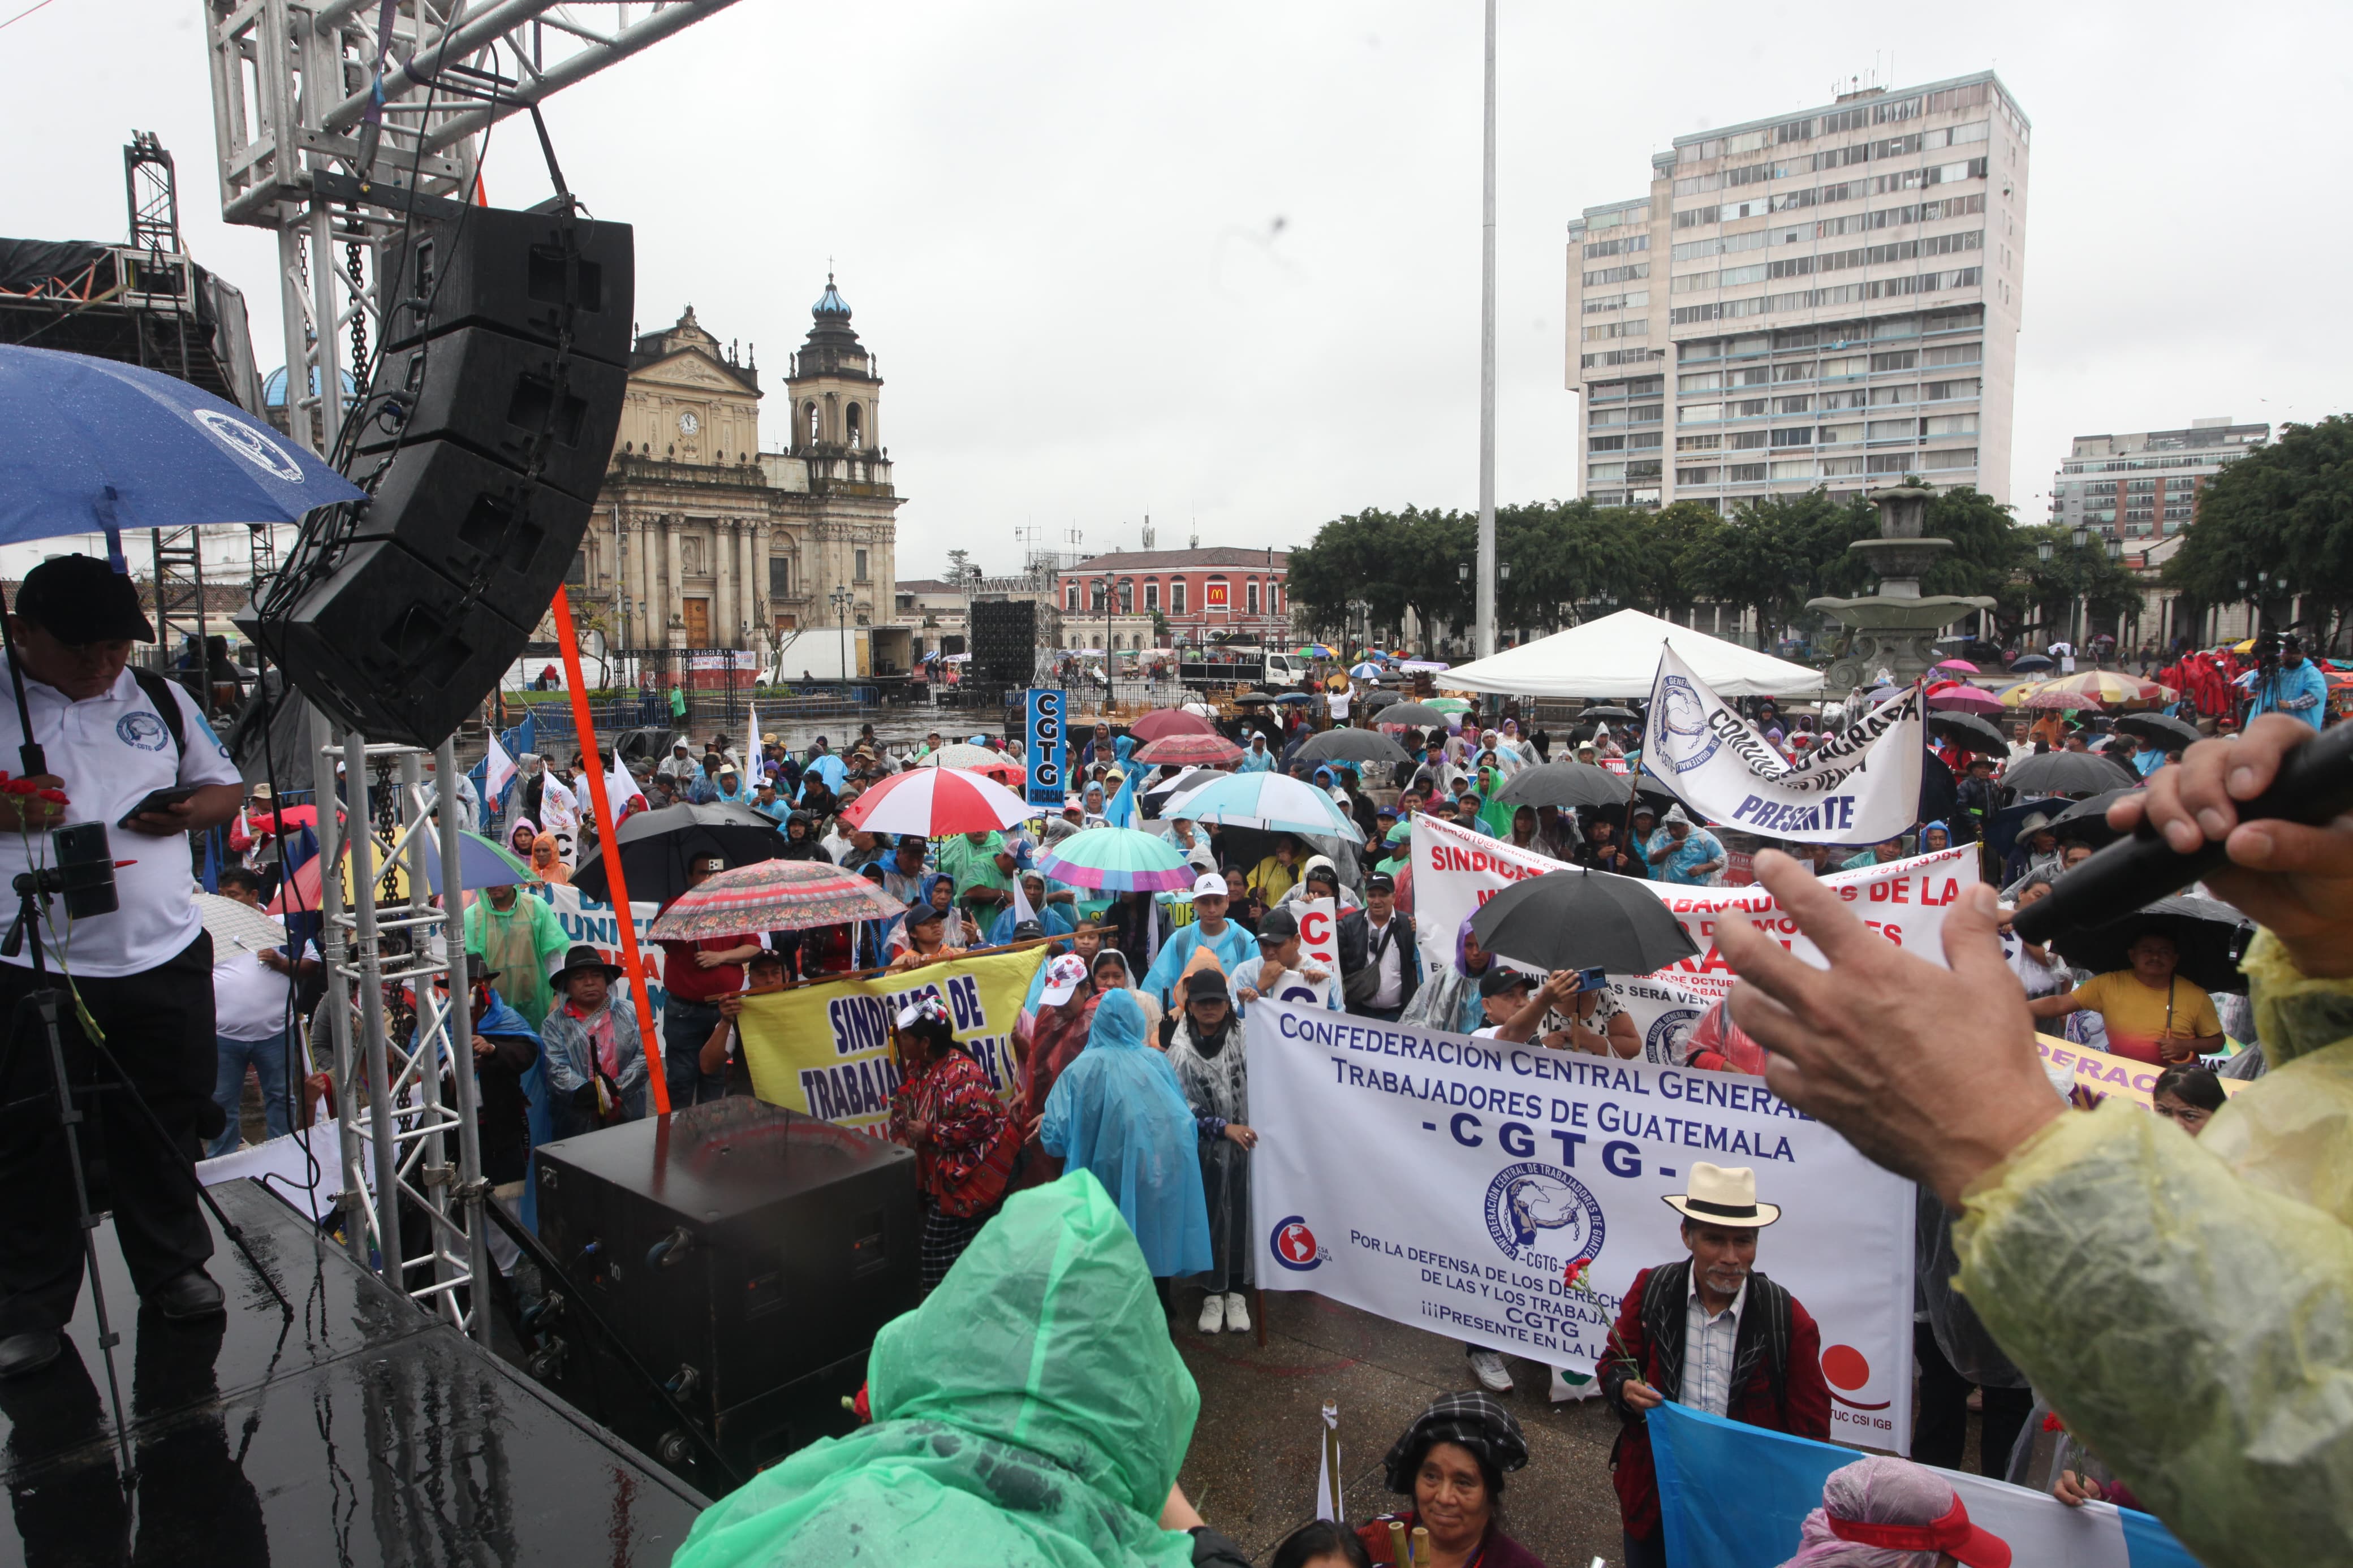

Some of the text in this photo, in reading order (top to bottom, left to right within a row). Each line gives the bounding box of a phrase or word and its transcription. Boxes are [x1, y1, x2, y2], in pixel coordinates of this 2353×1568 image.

[1030, 788, 1063, 804] CHICACAO
[1732, 794, 1855, 832] PRESENTE
[1870, 876, 1910, 904] DE
[1921, 876, 1959, 906] LA
[947, 976, 984, 1031] DE
[1630, 987, 1671, 1002] SERÁ
[1649, 1022, 1666, 1043] CENTRAL
[1280, 1013, 1502, 1072] CONFEDERACIÓN
[1511, 1051, 1650, 1096] CENTRAL
[1331, 1056, 1795, 1163] TRABAJADORES DE GUATEMALA
[1495, 1164, 1527, 1188] CENTRAL
[1527, 1164, 1539, 1173] DE
[1540, 1164, 1598, 1213] TRABAJADORES
[1487, 1186, 1516, 1258] CONFEDERACIÓN
[1592, 1216, 1602, 1226] DE
[1317, 1246, 1329, 1254] CSA
[1318, 1252, 1333, 1262] TUCA
[1351, 1229, 1381, 1252] POR
[1385, 1242, 1403, 1258] LA
[1408, 1247, 1481, 1277] DEFENSA
[1485, 1266, 1507, 1284] DE
[1512, 1273, 1544, 1291] LOS
[1421, 1269, 1620, 1327] DE LAS Y LOS TRABAJA
[1421, 1301, 1528, 1342] ¡¡¡PRESENTE
[1533, 1333, 1557, 1349] EN
[1563, 1340, 1585, 1357] LA
[1506, 1307, 1580, 1338] CGTG
[1852, 1414, 1869, 1426] CSI
[1873, 1418, 1892, 1430] IGB
